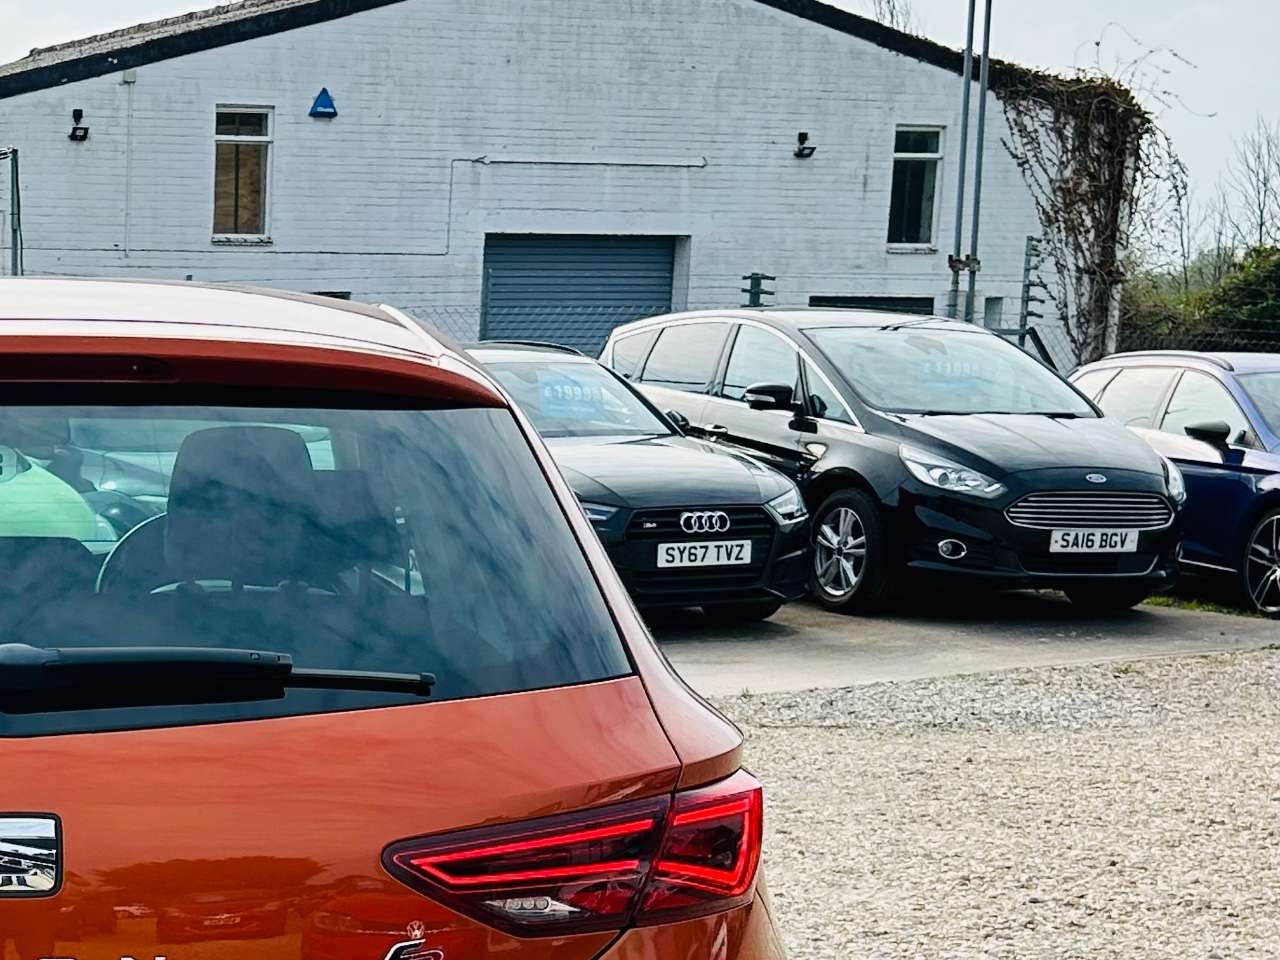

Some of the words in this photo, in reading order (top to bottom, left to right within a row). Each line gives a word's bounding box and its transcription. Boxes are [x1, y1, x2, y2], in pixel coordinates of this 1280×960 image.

[1060, 533, 1096, 549] SA16
[1098, 532, 1128, 549] BGV
[665, 546, 709, 563] SY67
[714, 543, 745, 562] TVZ
